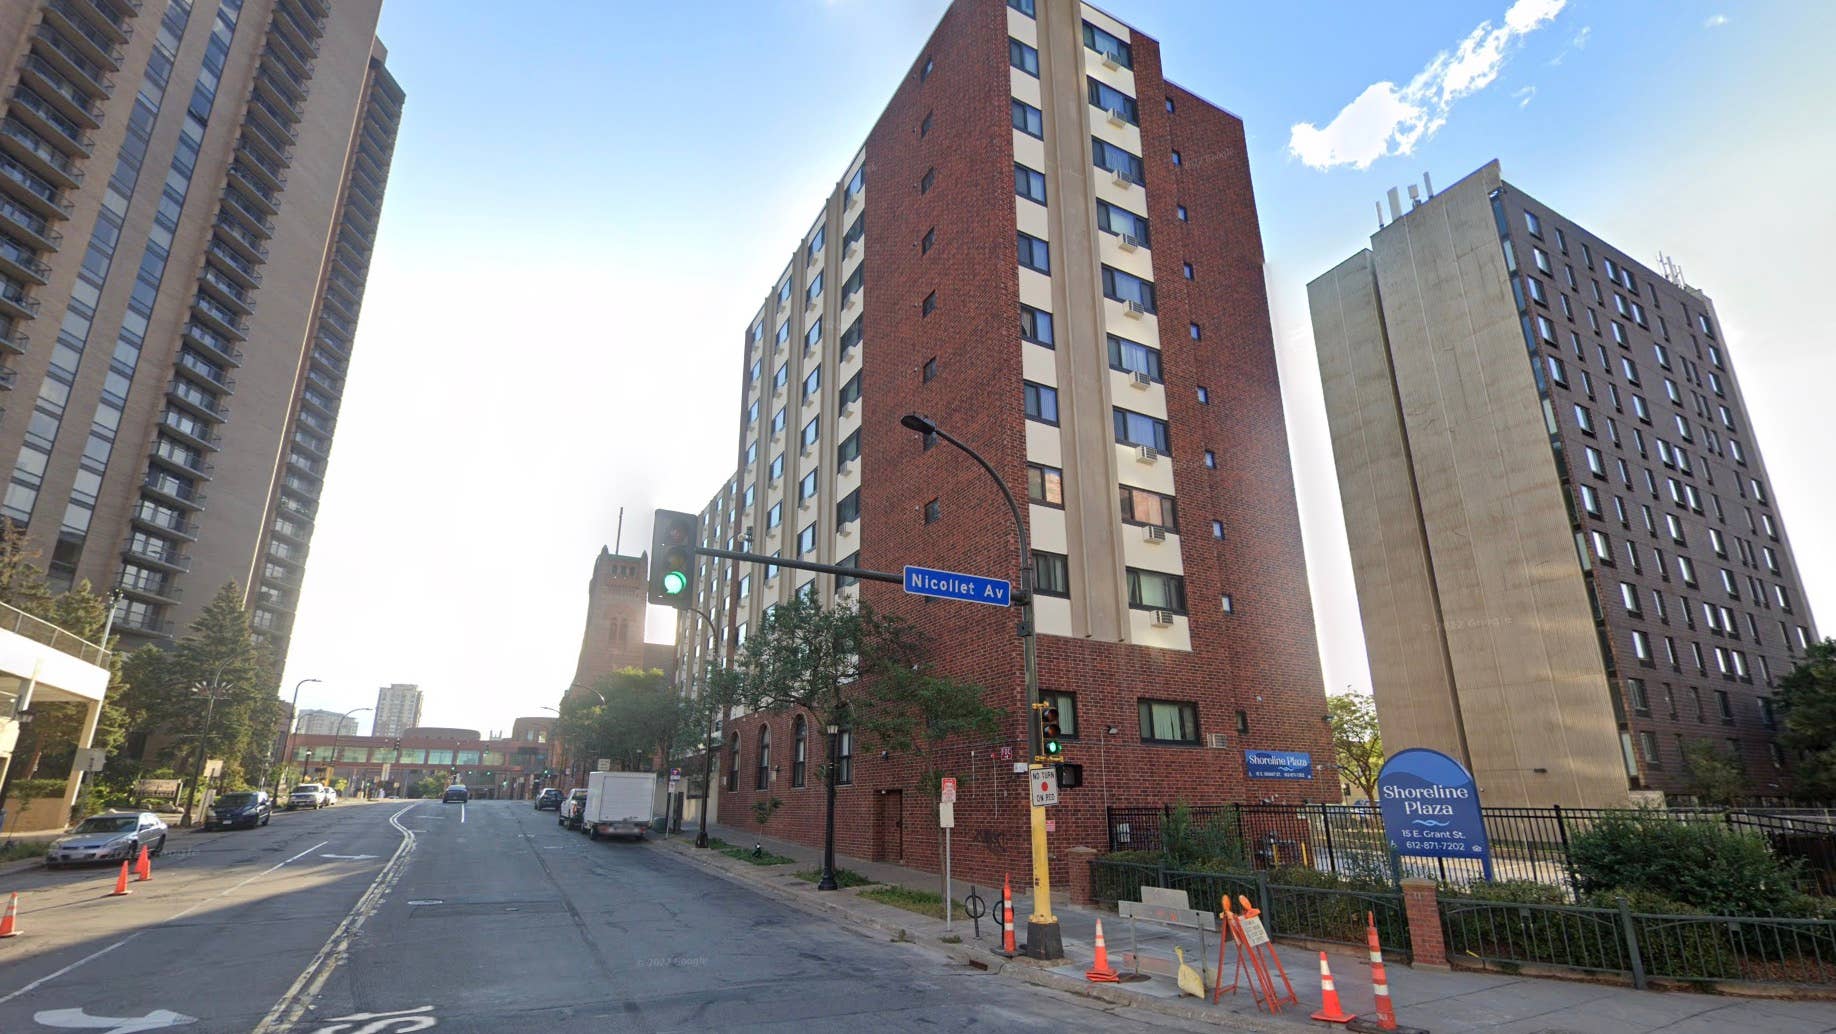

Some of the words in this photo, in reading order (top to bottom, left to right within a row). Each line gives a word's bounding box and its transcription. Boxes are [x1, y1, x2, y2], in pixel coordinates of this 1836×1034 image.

[911, 573, 975, 596] Nicollet
[984, 584, 1004, 599] Av
[1248, 754, 1286, 766] Shoreline
[1287, 756, 1308, 767] Plaza
[1033, 772, 1040, 780] NO
[1041, 771, 1055, 779] TURN
[1383, 784, 1469, 799] Shoreline
[1404, 801, 1454, 815] Plaza
[1401, 829, 1412, 837] 15
[1423, 830, 1451, 839] Grant
[1452, 830, 1466, 839] St.
[1406, 841, 1465, 851] 612-871-7202
